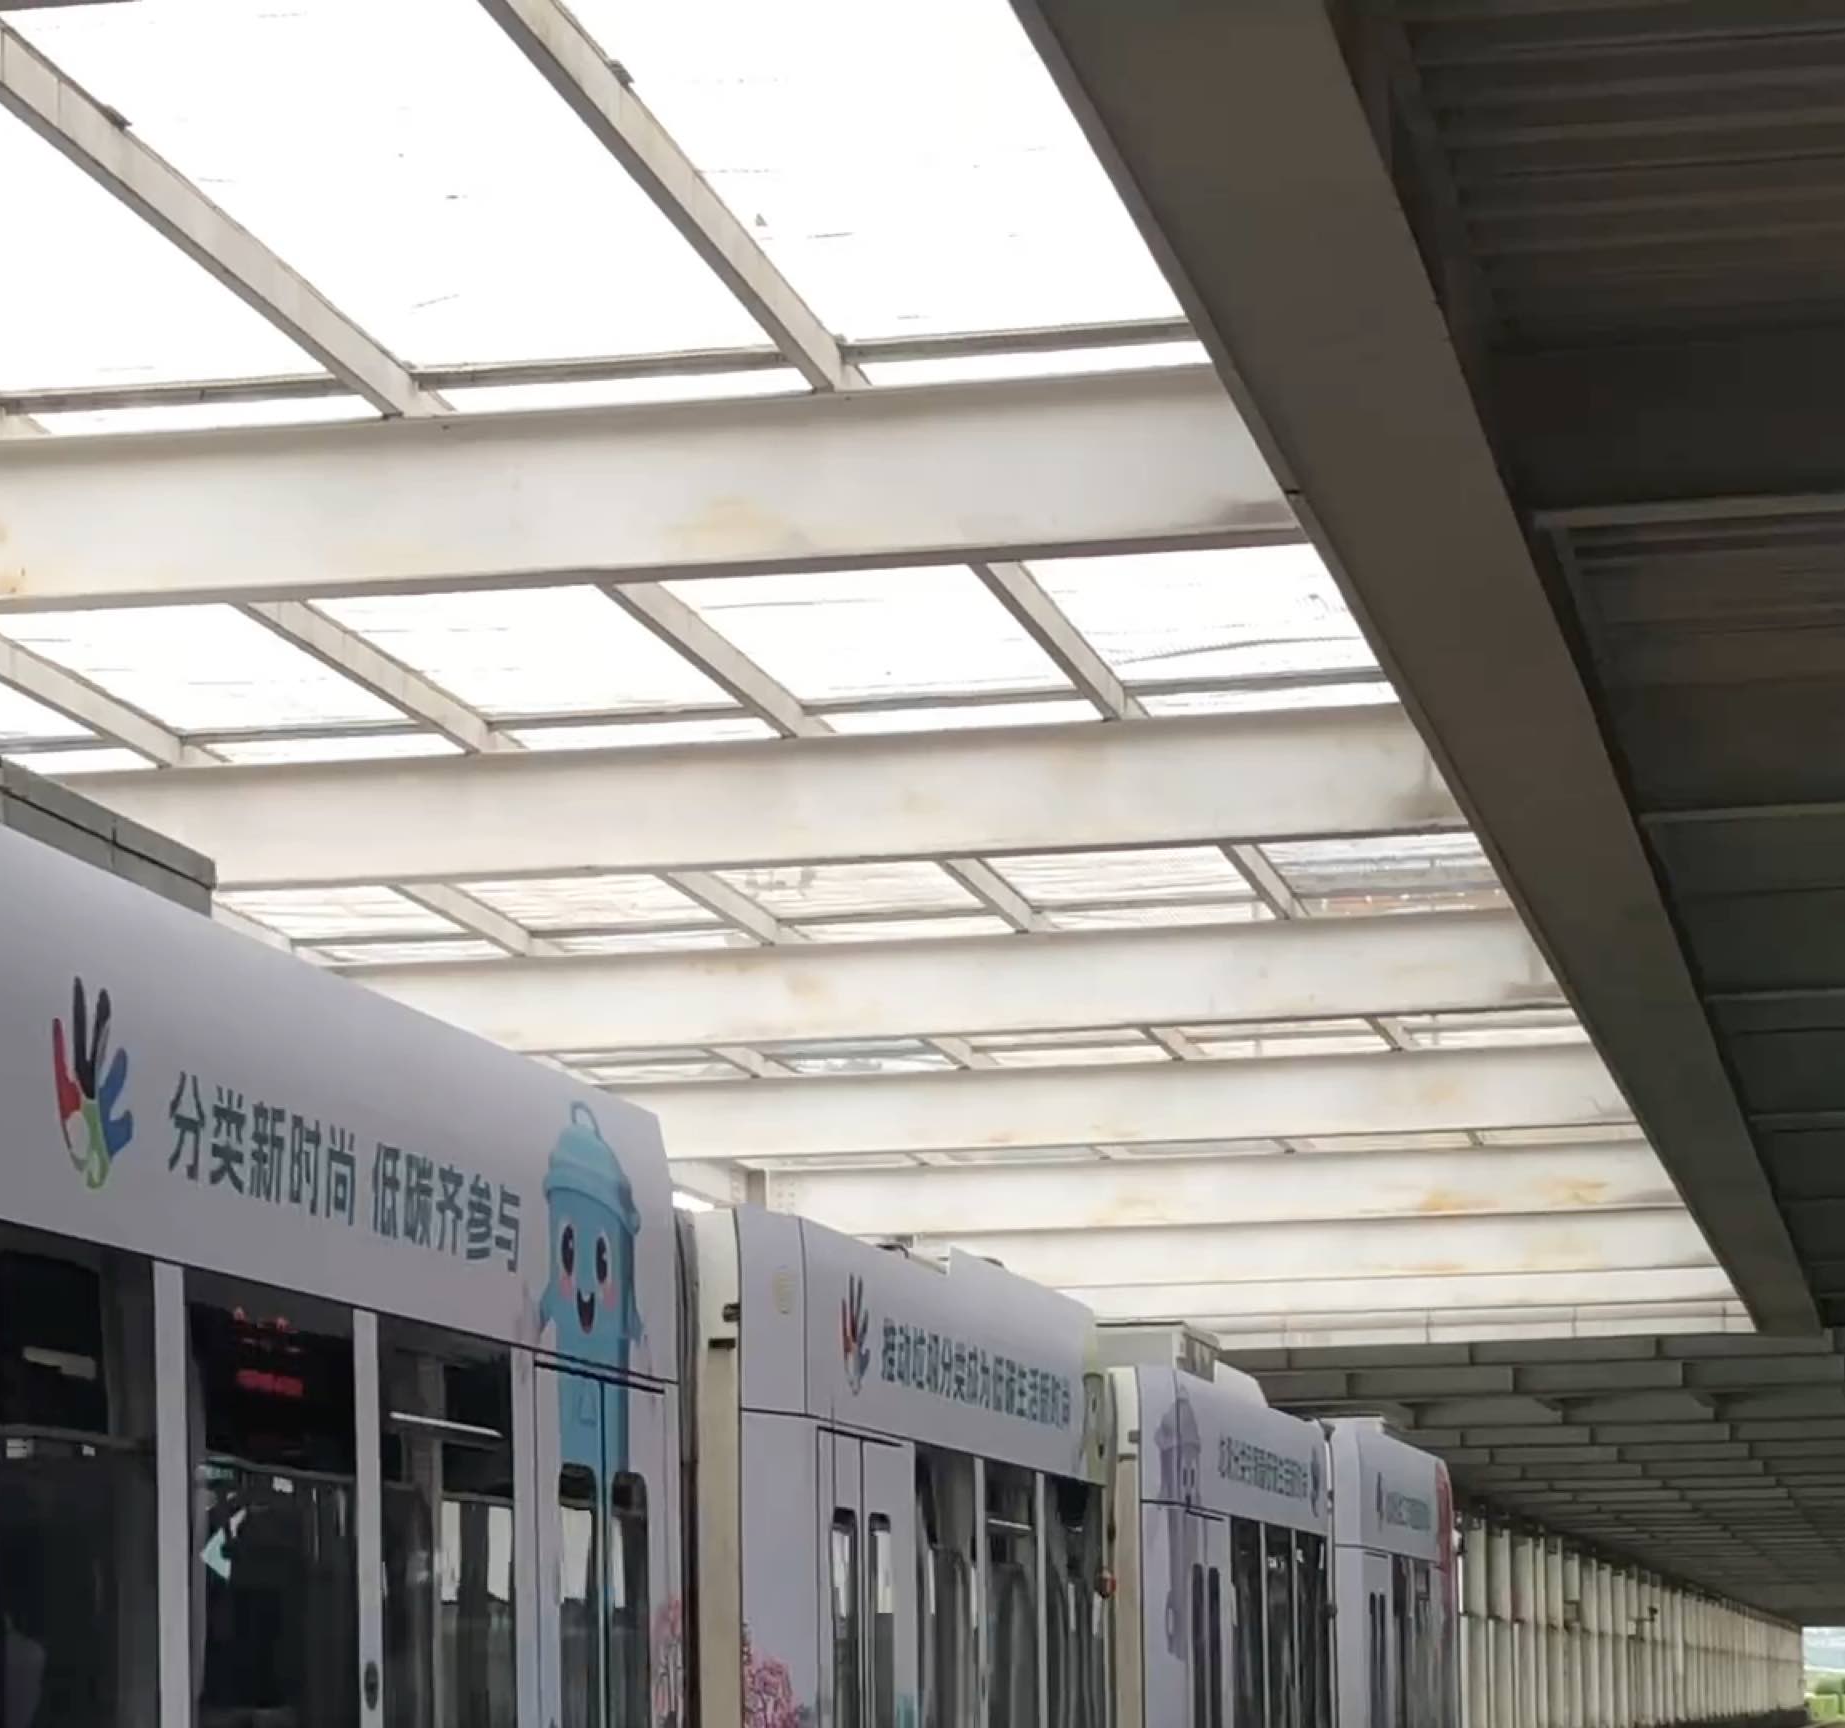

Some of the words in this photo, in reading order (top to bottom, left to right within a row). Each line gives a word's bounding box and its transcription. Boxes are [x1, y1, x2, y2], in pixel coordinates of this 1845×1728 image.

[168, 1072, 357, 1226] 分类新时尚
[372, 1142, 523, 1274] 低碳齐参与
